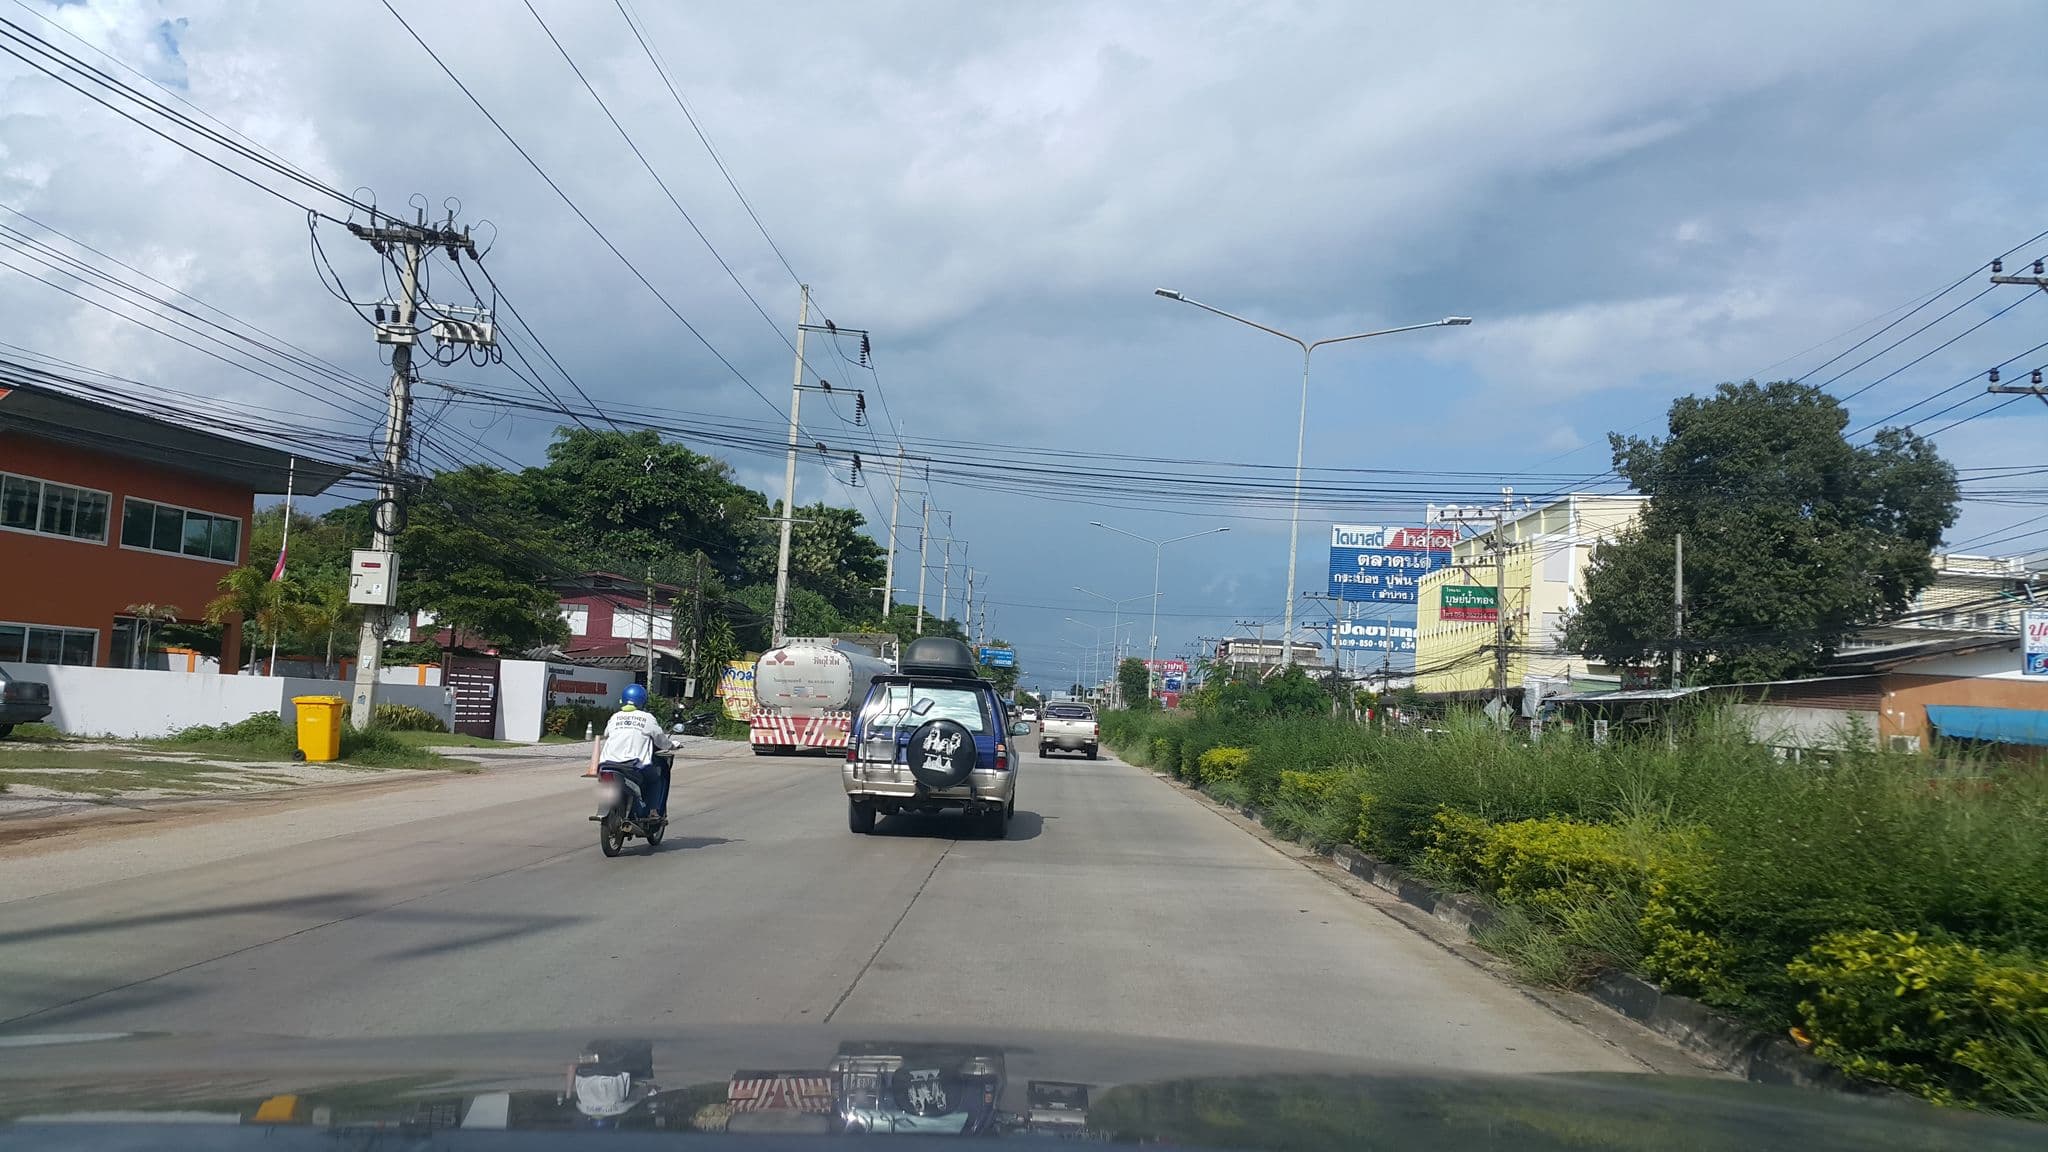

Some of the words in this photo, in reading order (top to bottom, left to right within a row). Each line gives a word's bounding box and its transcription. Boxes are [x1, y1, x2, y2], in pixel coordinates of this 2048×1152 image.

[1334, 525, 1387, 547] ไดนาสตี้
[1357, 551, 1432, 569] ตลาดนัด
[616, 715, 647, 723] TOGETHER
